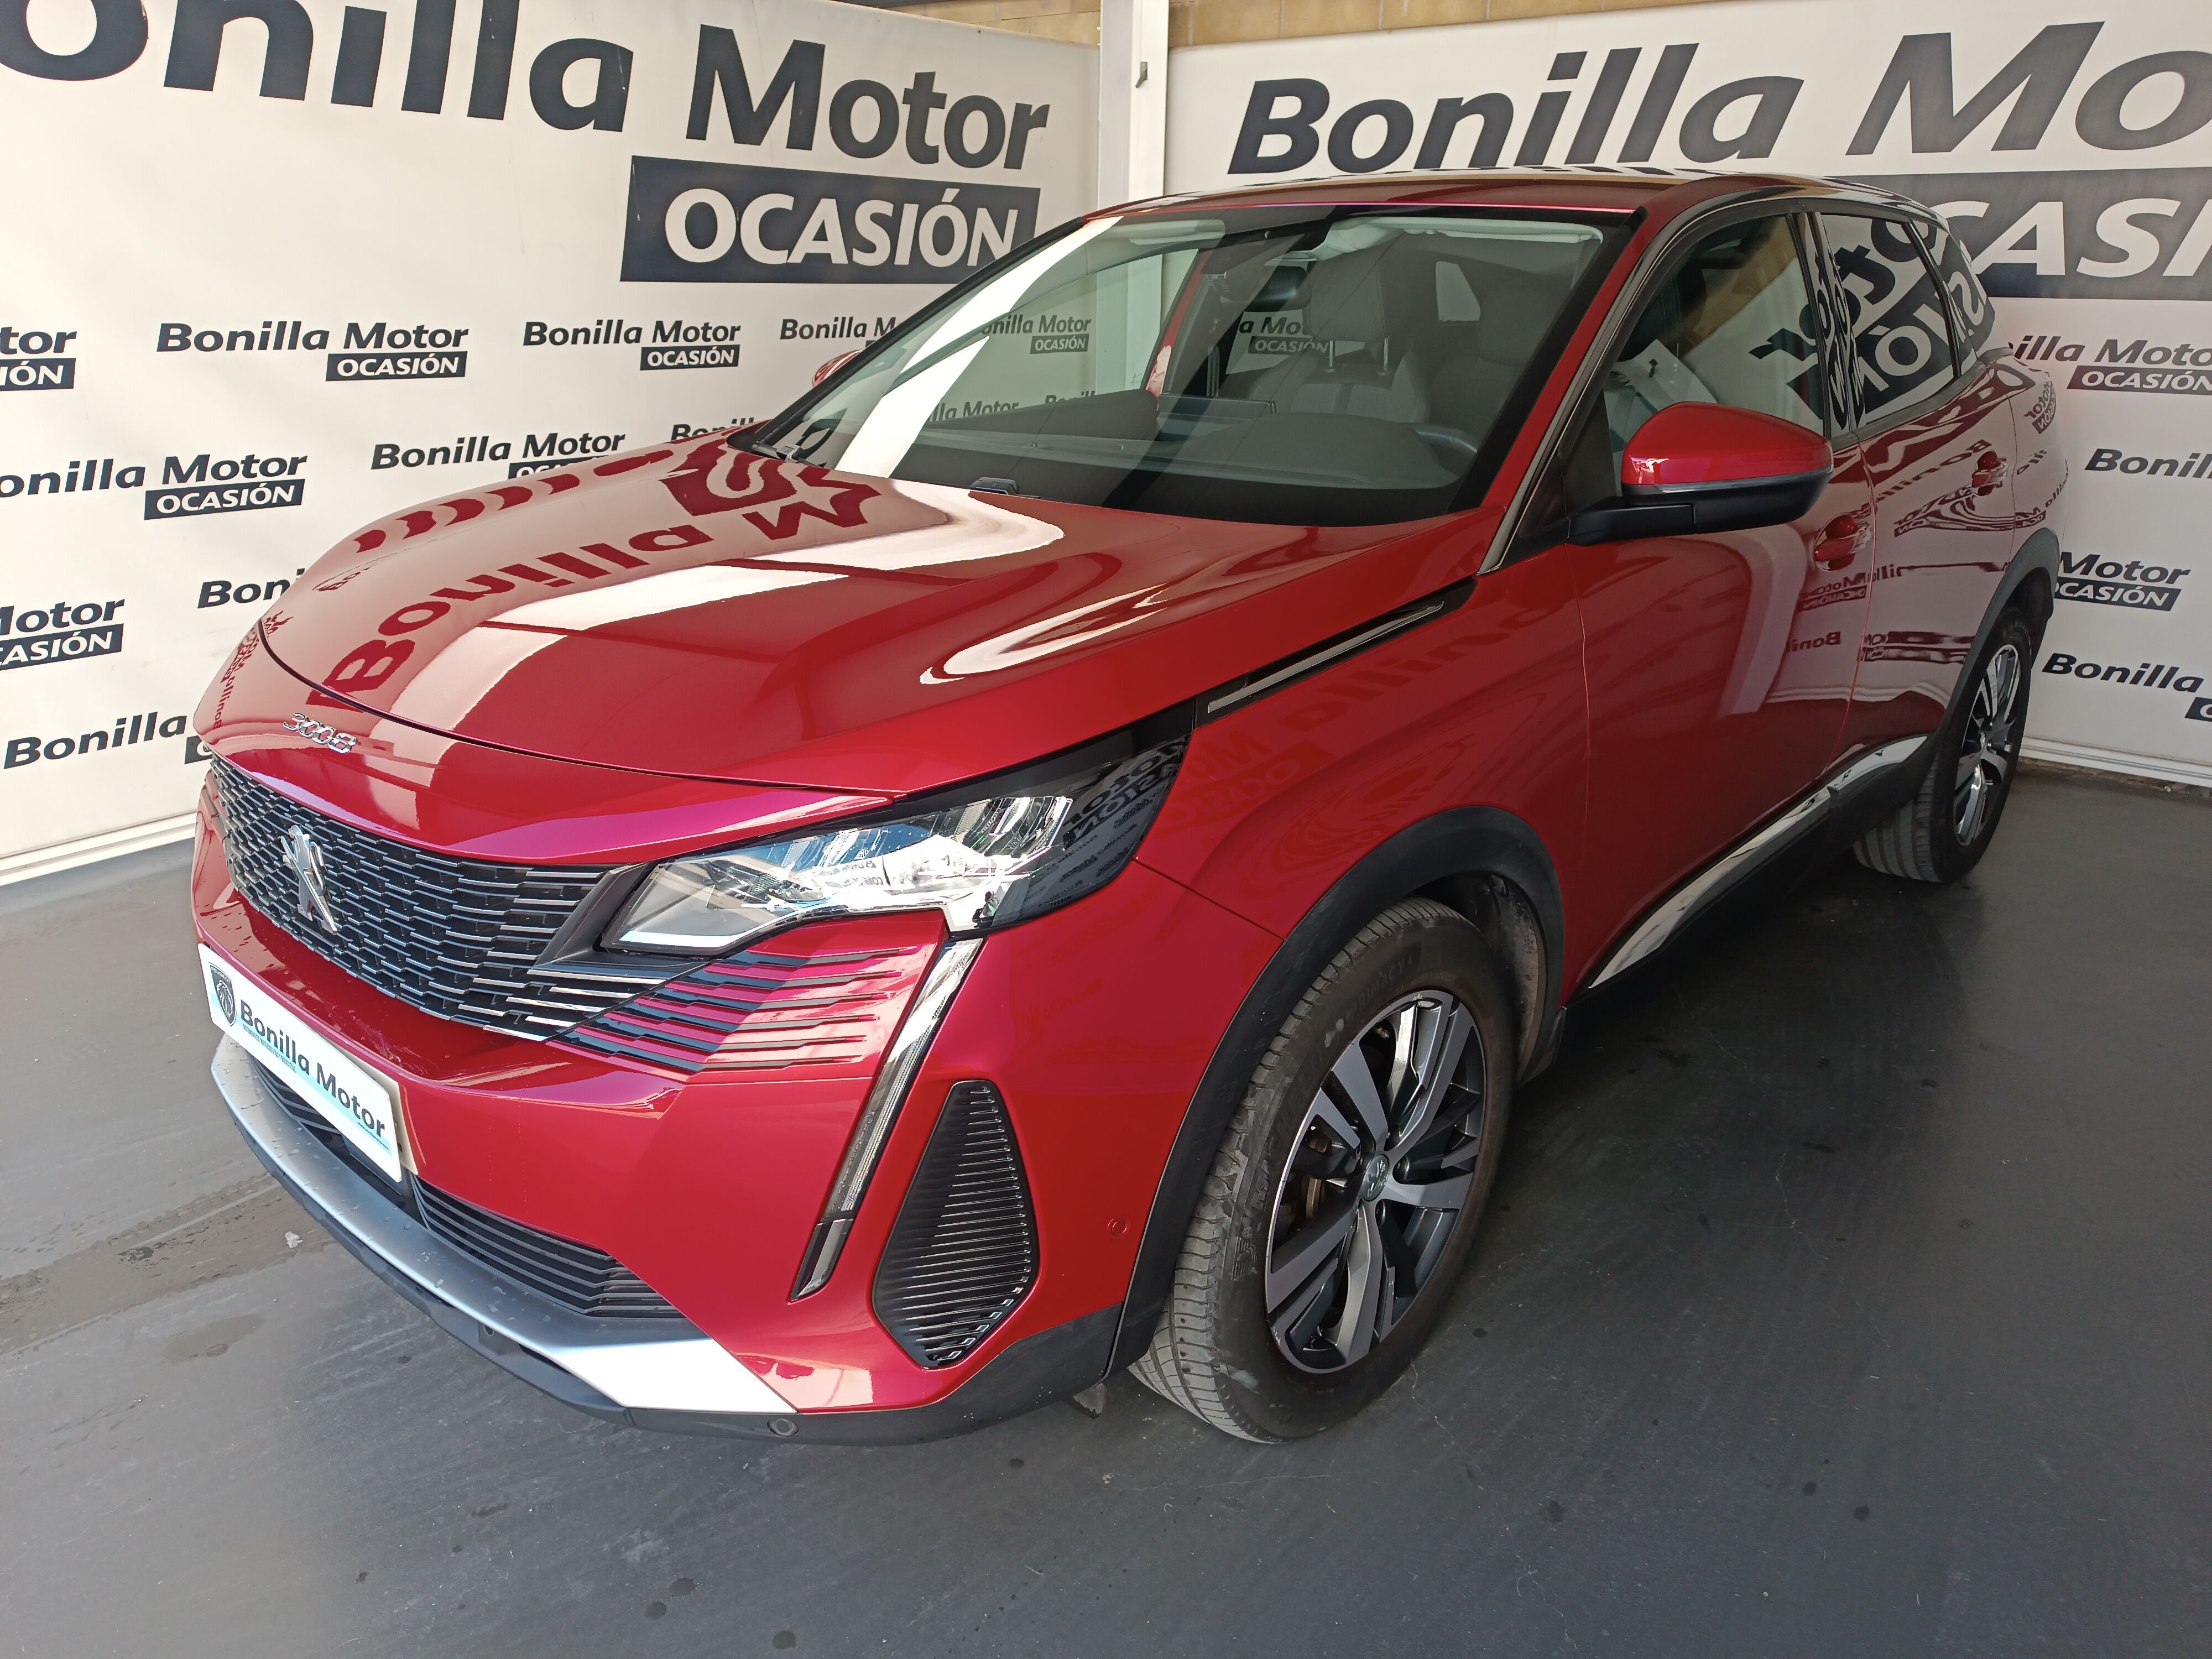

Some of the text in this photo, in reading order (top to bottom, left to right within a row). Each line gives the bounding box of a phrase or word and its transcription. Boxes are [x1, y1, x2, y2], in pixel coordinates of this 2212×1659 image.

[686, 24, 1050, 170] Motor
[1228, 43, 1804, 174] Bonilla
[665, 188, 1018, 267] OCASIÓN
[156, 321, 469, 352] Bonilla Motor
[523, 320, 741, 346] Bonilla Motor
[780, 316, 867, 340] Bonilla
[1039, 315, 1092, 333] Motor
[648, 347, 734, 366] OCASIÓN
[1035, 335, 1086, 352] OCASIÓN
[336, 354, 459, 376] OCASIÓN
[371, 432, 625, 469] Bonilla Motor
[2084, 448, 2212, 479] Bonil
[162, 454, 307, 484] Motor
[156, 483, 295, 513] OCASIÓN
[2060, 552, 2191, 585] Motor
[0, 631, 113, 665] ASIÓN
[2042, 653, 2204, 693] Bonilla
[4, 712, 187, 769] Bonilla
[283, 712, 358, 754] 3008
[240, 999, 310, 1076] Bonilla
[317, 1062, 385, 1137] Motor
